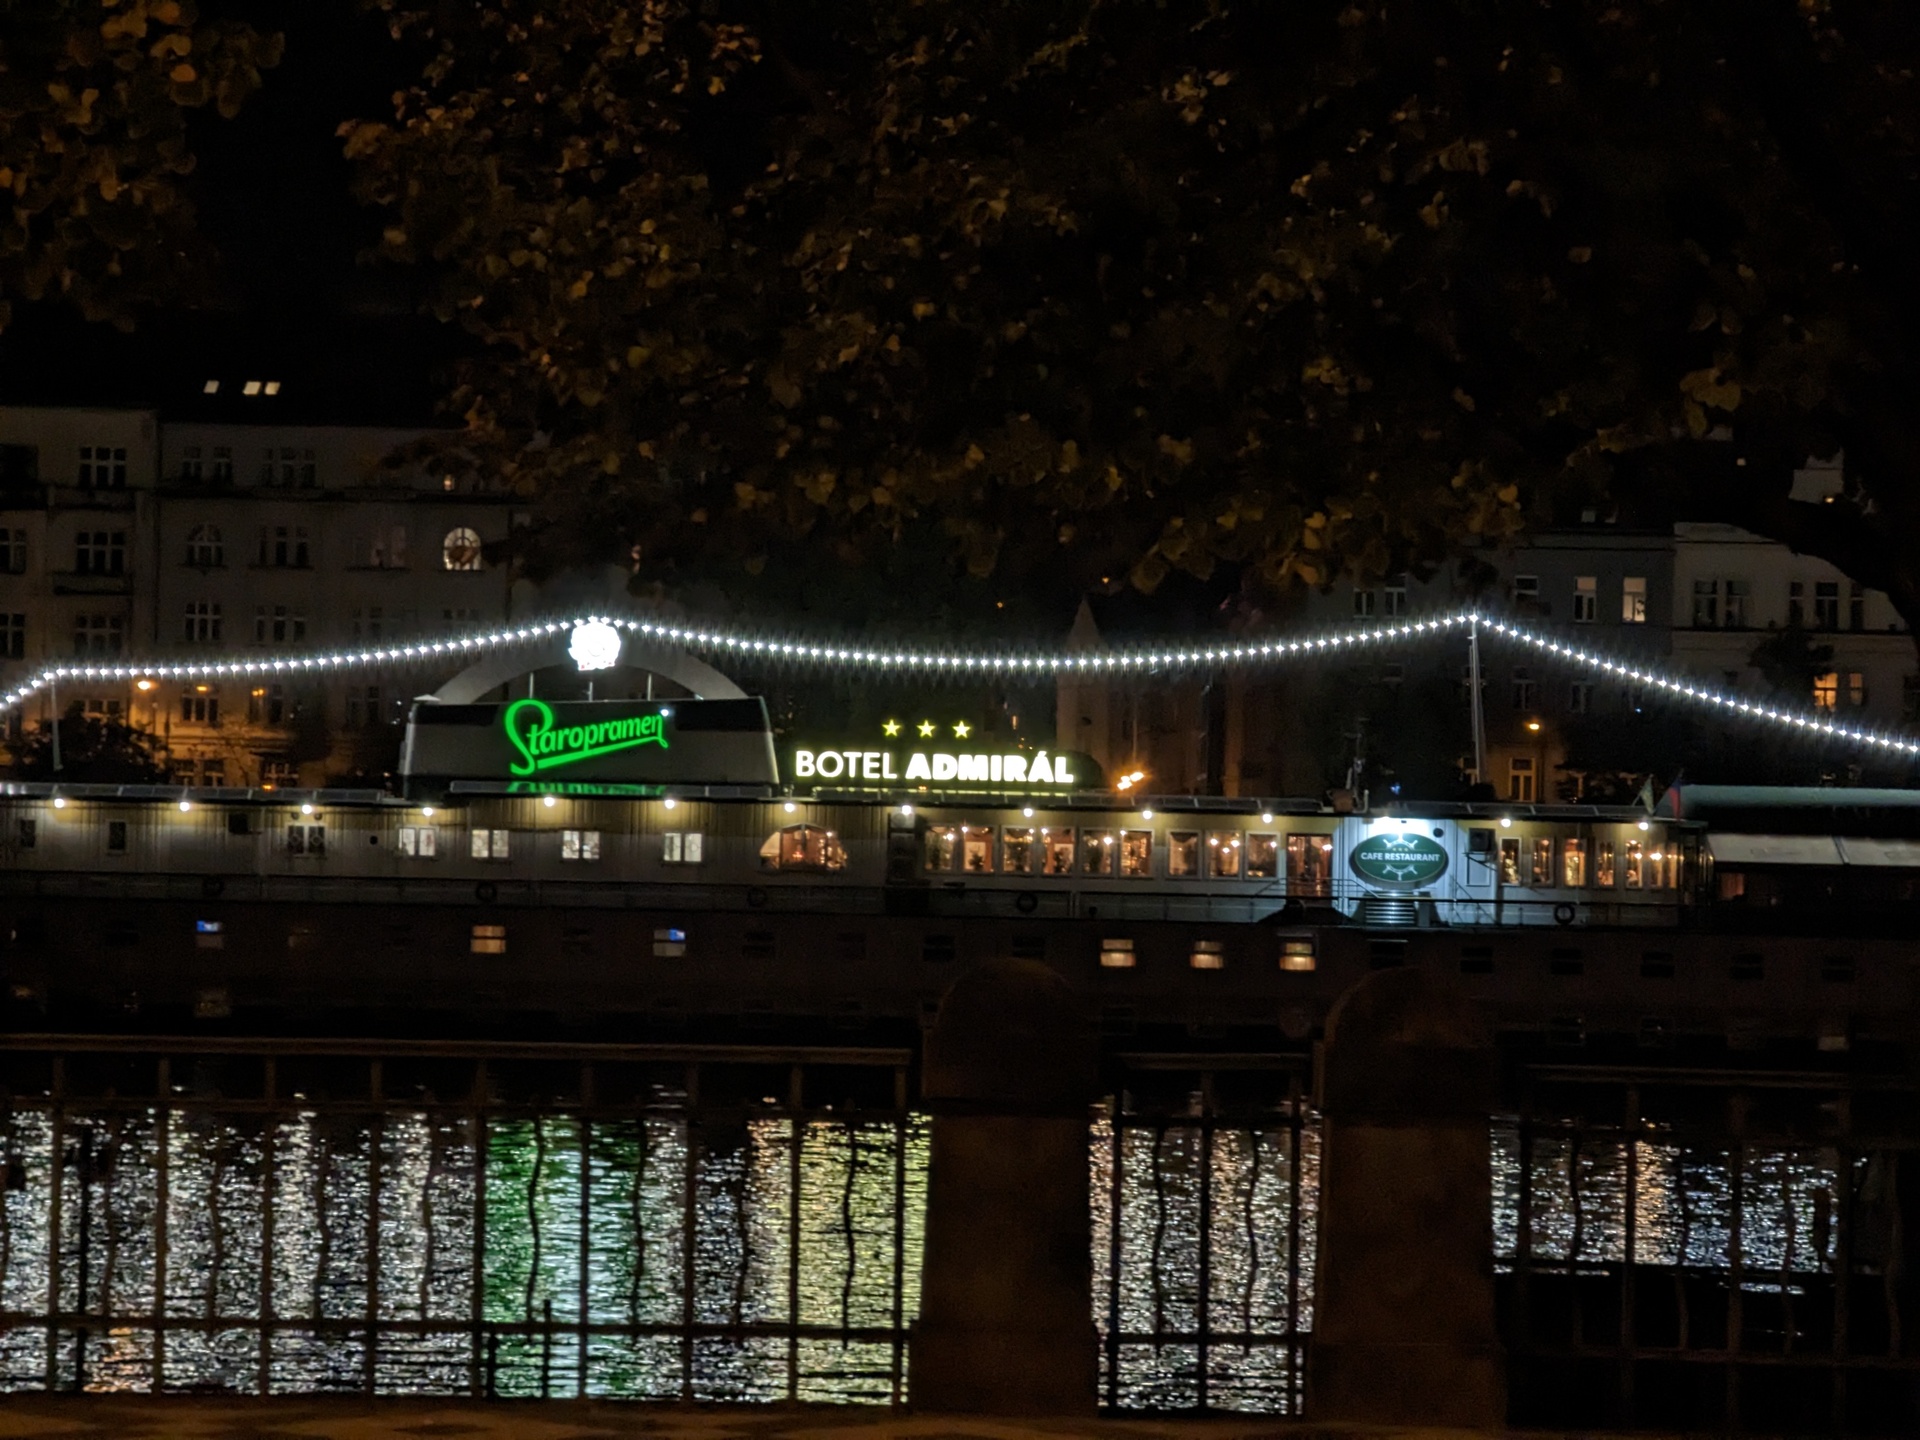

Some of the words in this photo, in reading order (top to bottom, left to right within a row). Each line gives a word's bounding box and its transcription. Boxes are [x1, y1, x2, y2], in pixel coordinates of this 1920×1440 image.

[505, 699, 669, 774] Staropramen
[795, 750, 897, 780] BOTEL
[905, 750, 1074, 784] ADMIRÁL
[1361, 851, 1383, 860] CAFE
[1384, 852, 1440, 861] RESTAURANT
